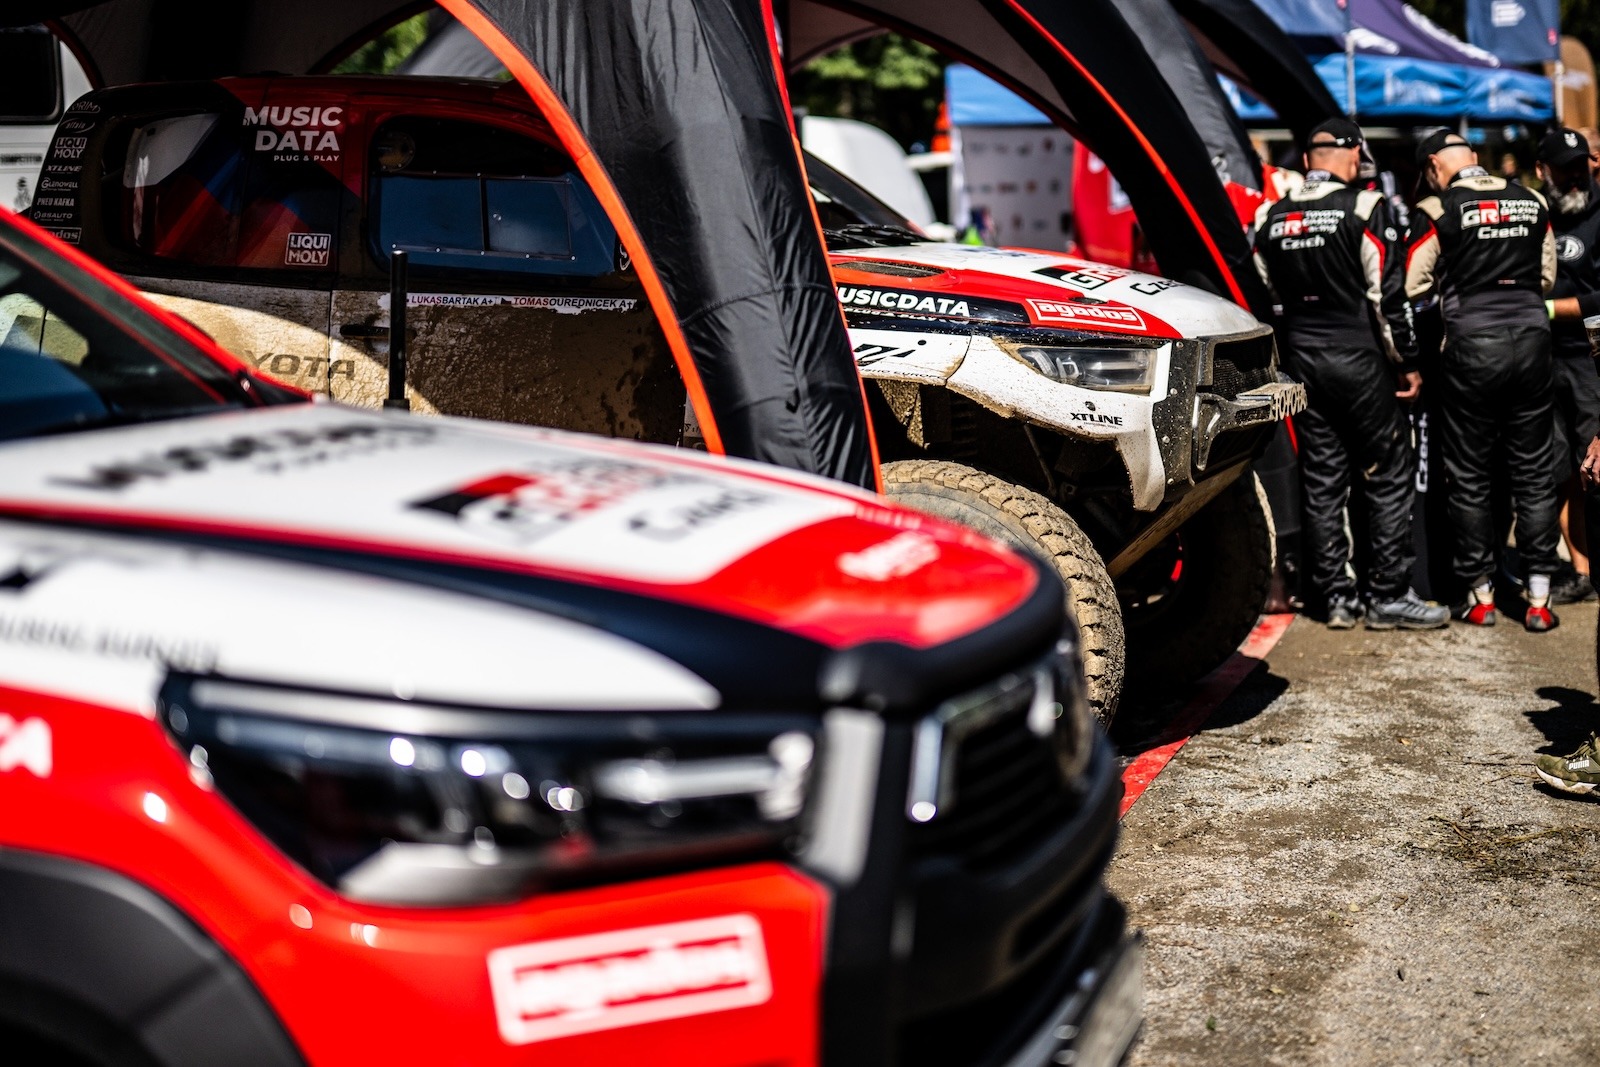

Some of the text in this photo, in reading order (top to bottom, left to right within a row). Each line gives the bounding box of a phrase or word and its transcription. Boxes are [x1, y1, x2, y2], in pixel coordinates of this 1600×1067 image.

[242, 106, 343, 126] MUSIC
[57, 138, 86, 147] LIQUI
[255, 130, 340, 151] DATA
[54, 149, 83, 158] MOLY
[53, 198, 74, 206] KAFKA
[1461, 207, 1500, 228] GR
[1478, 225, 1528, 239] Czech
[290, 236, 328, 248] LIQUI
[1281, 235, 1325, 250] Czech
[288, 250, 327, 263] MOLY
[835, 287, 970, 318] USICDATA
[1037, 302, 1138, 321] agados
[1070, 413, 1123, 426] XTLINE
[1568, 759, 1590, 770] PUMA
